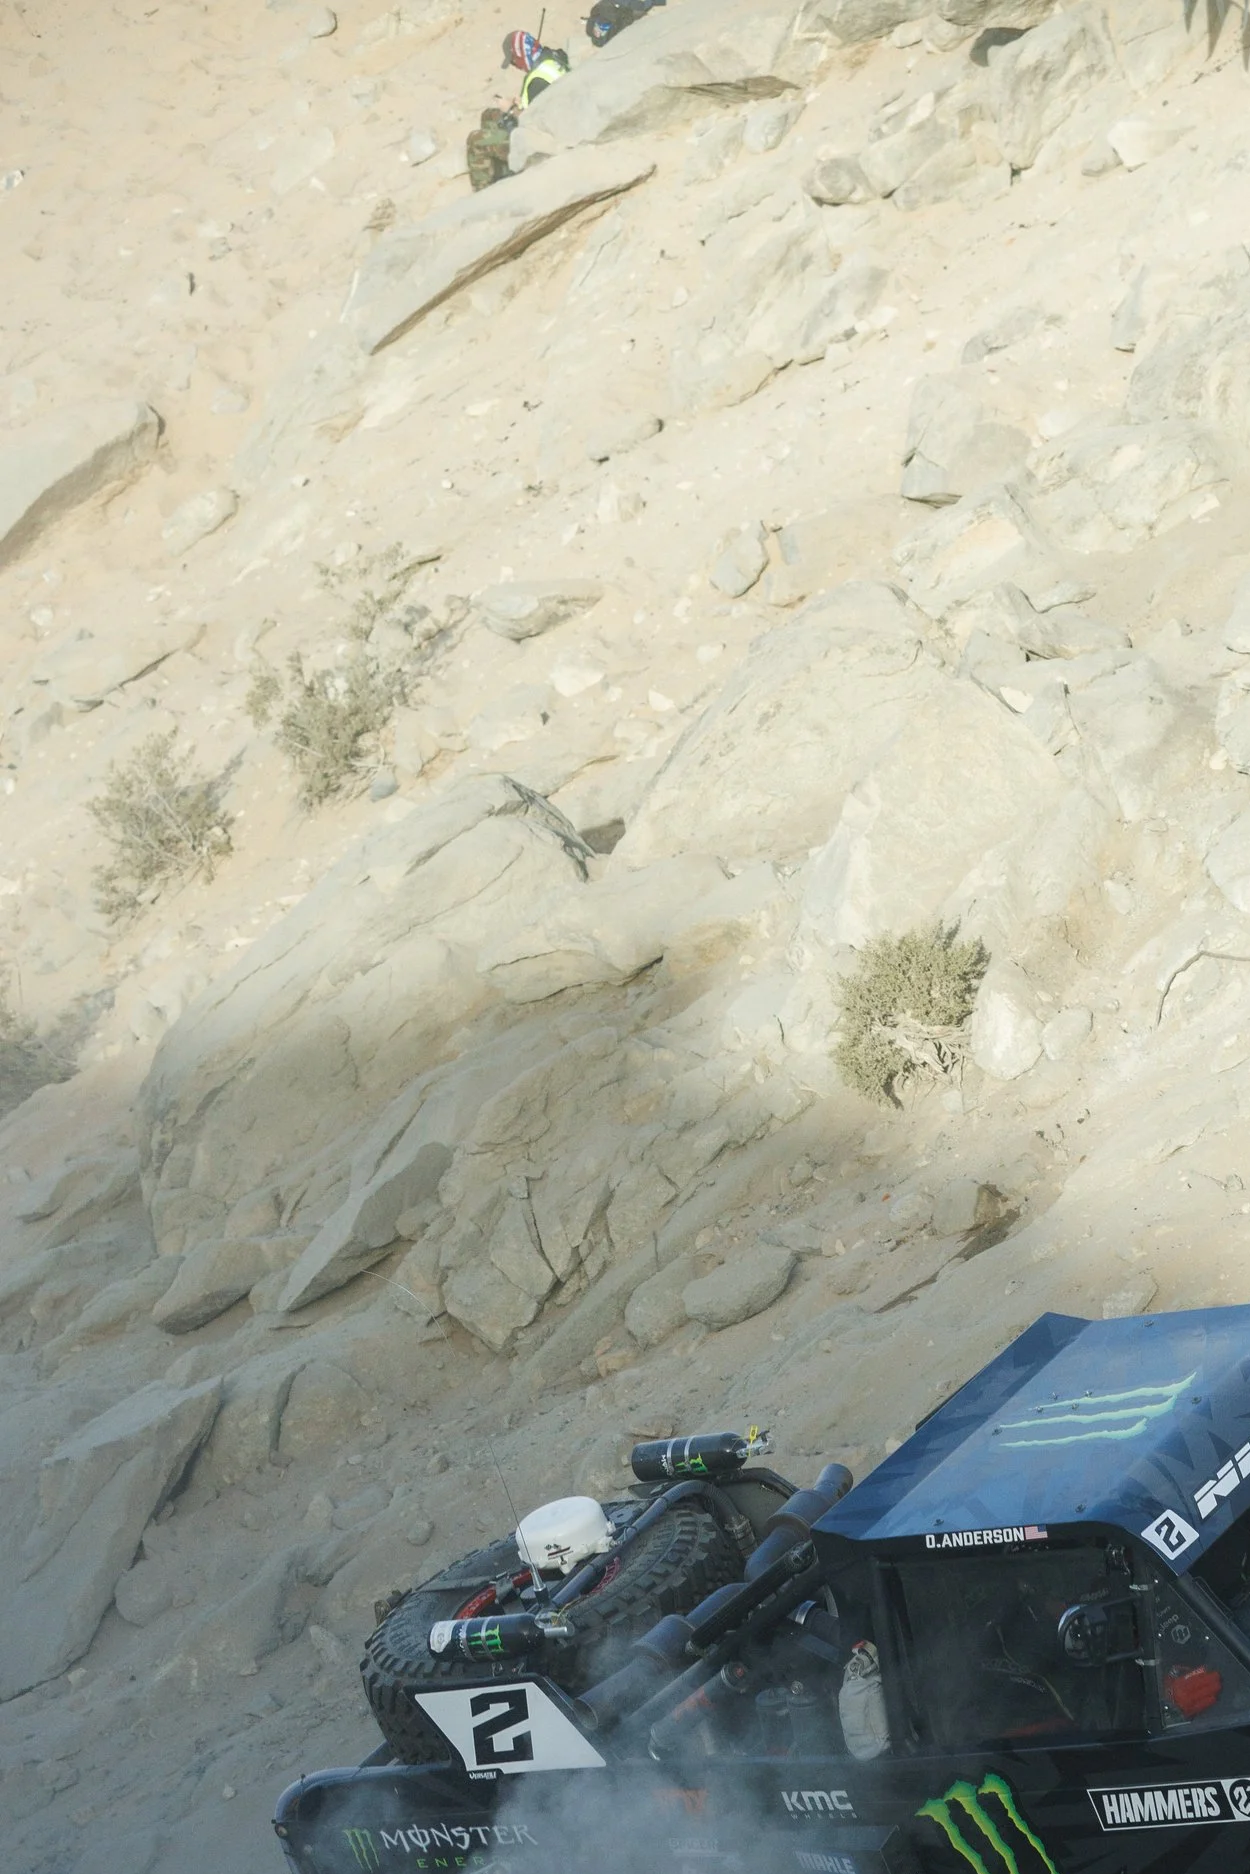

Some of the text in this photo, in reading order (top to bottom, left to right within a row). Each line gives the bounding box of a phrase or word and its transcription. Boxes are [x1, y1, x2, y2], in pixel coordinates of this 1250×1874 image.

[1154, 1516, 1187, 1553] 2
[470, 1688, 534, 1766] 2
[781, 1790, 854, 1811] KMC
[1102, 1787, 1221, 1825] HAMMERS
[379, 1822, 538, 1853] MONSTER
[416, 1855, 516, 1869] ENER
